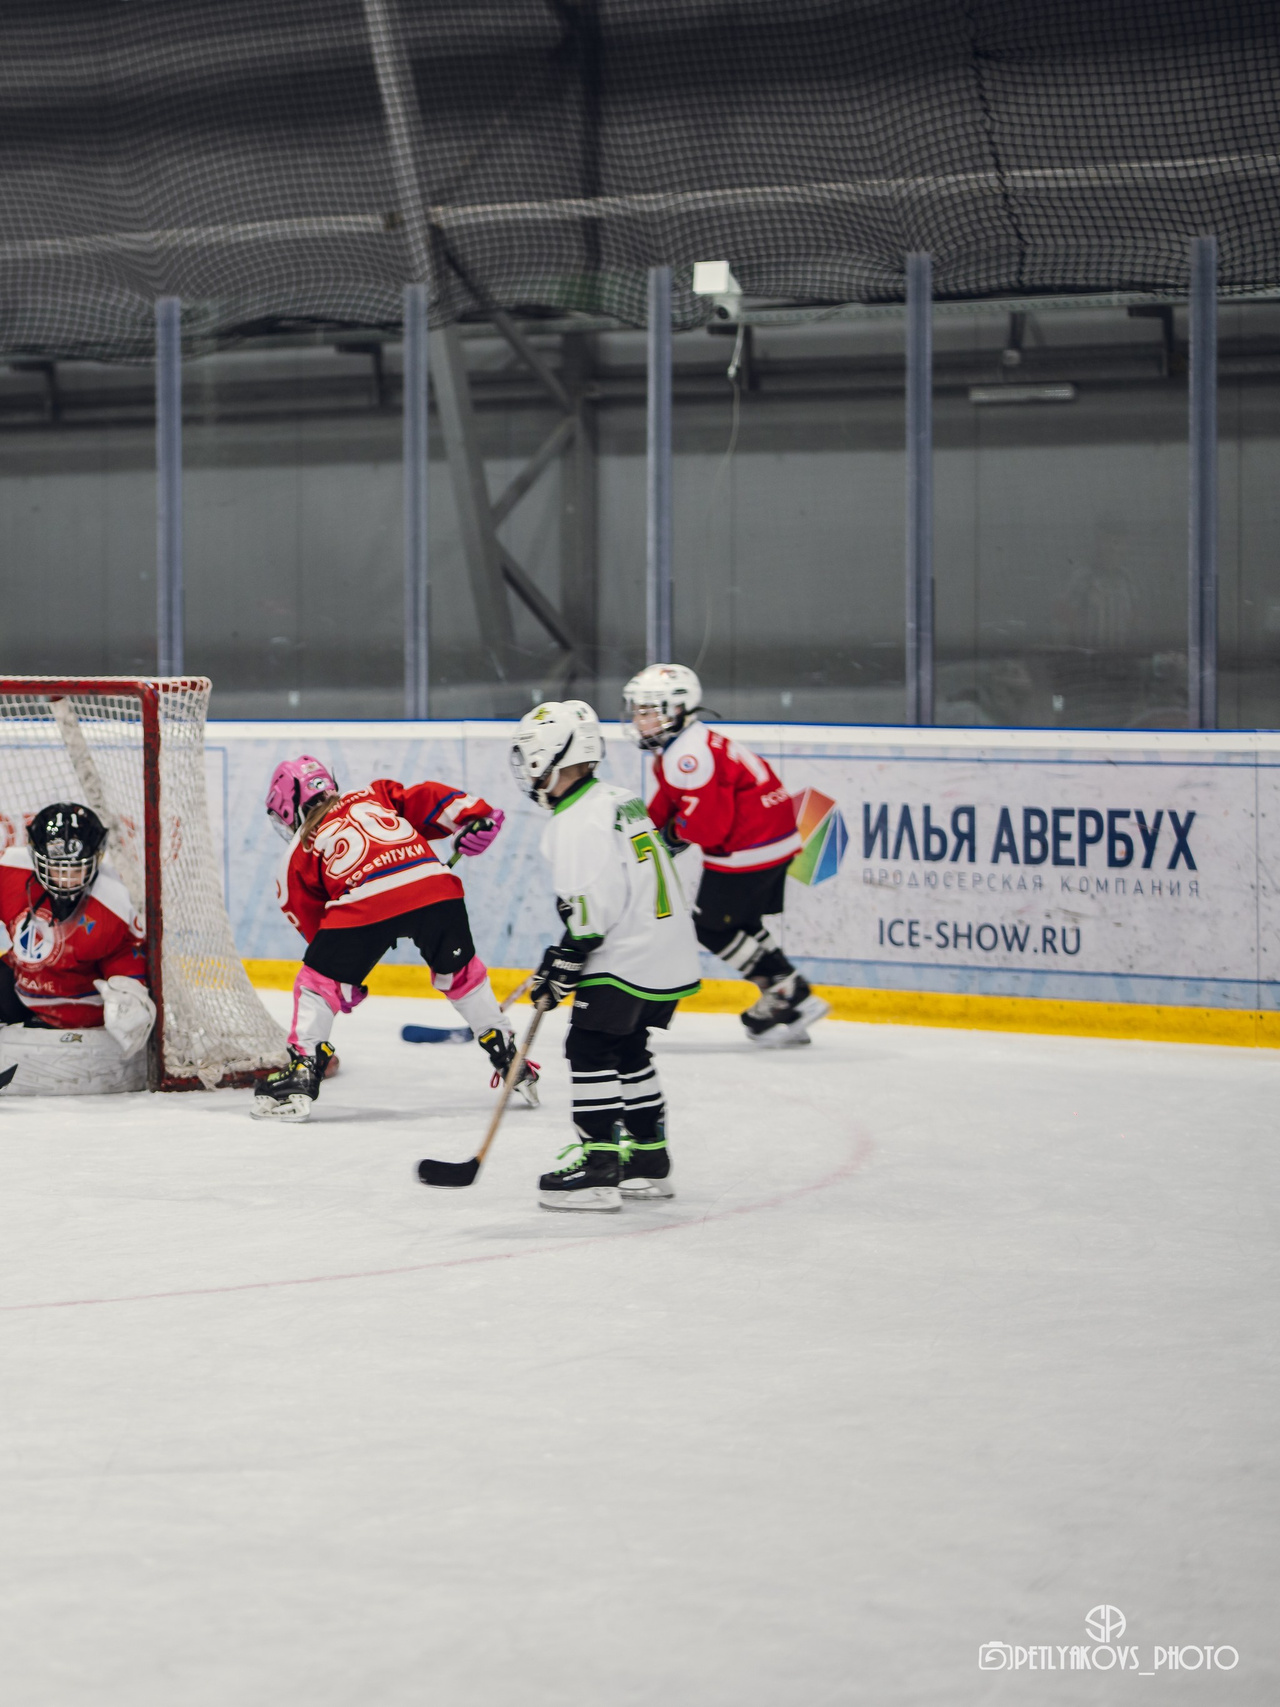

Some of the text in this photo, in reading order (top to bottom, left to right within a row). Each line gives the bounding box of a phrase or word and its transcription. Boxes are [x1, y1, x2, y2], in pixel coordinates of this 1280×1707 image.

[55, 812, 80, 829] 11
[862, 801, 1199, 871] ИЛЬЯ АВЕРБУХ
[862, 867, 1200, 898] ПРОДЮСЕРСКАЯ КОМПАНИЯ
[877, 917, 1082, 956] ICE-SHOW.RU
